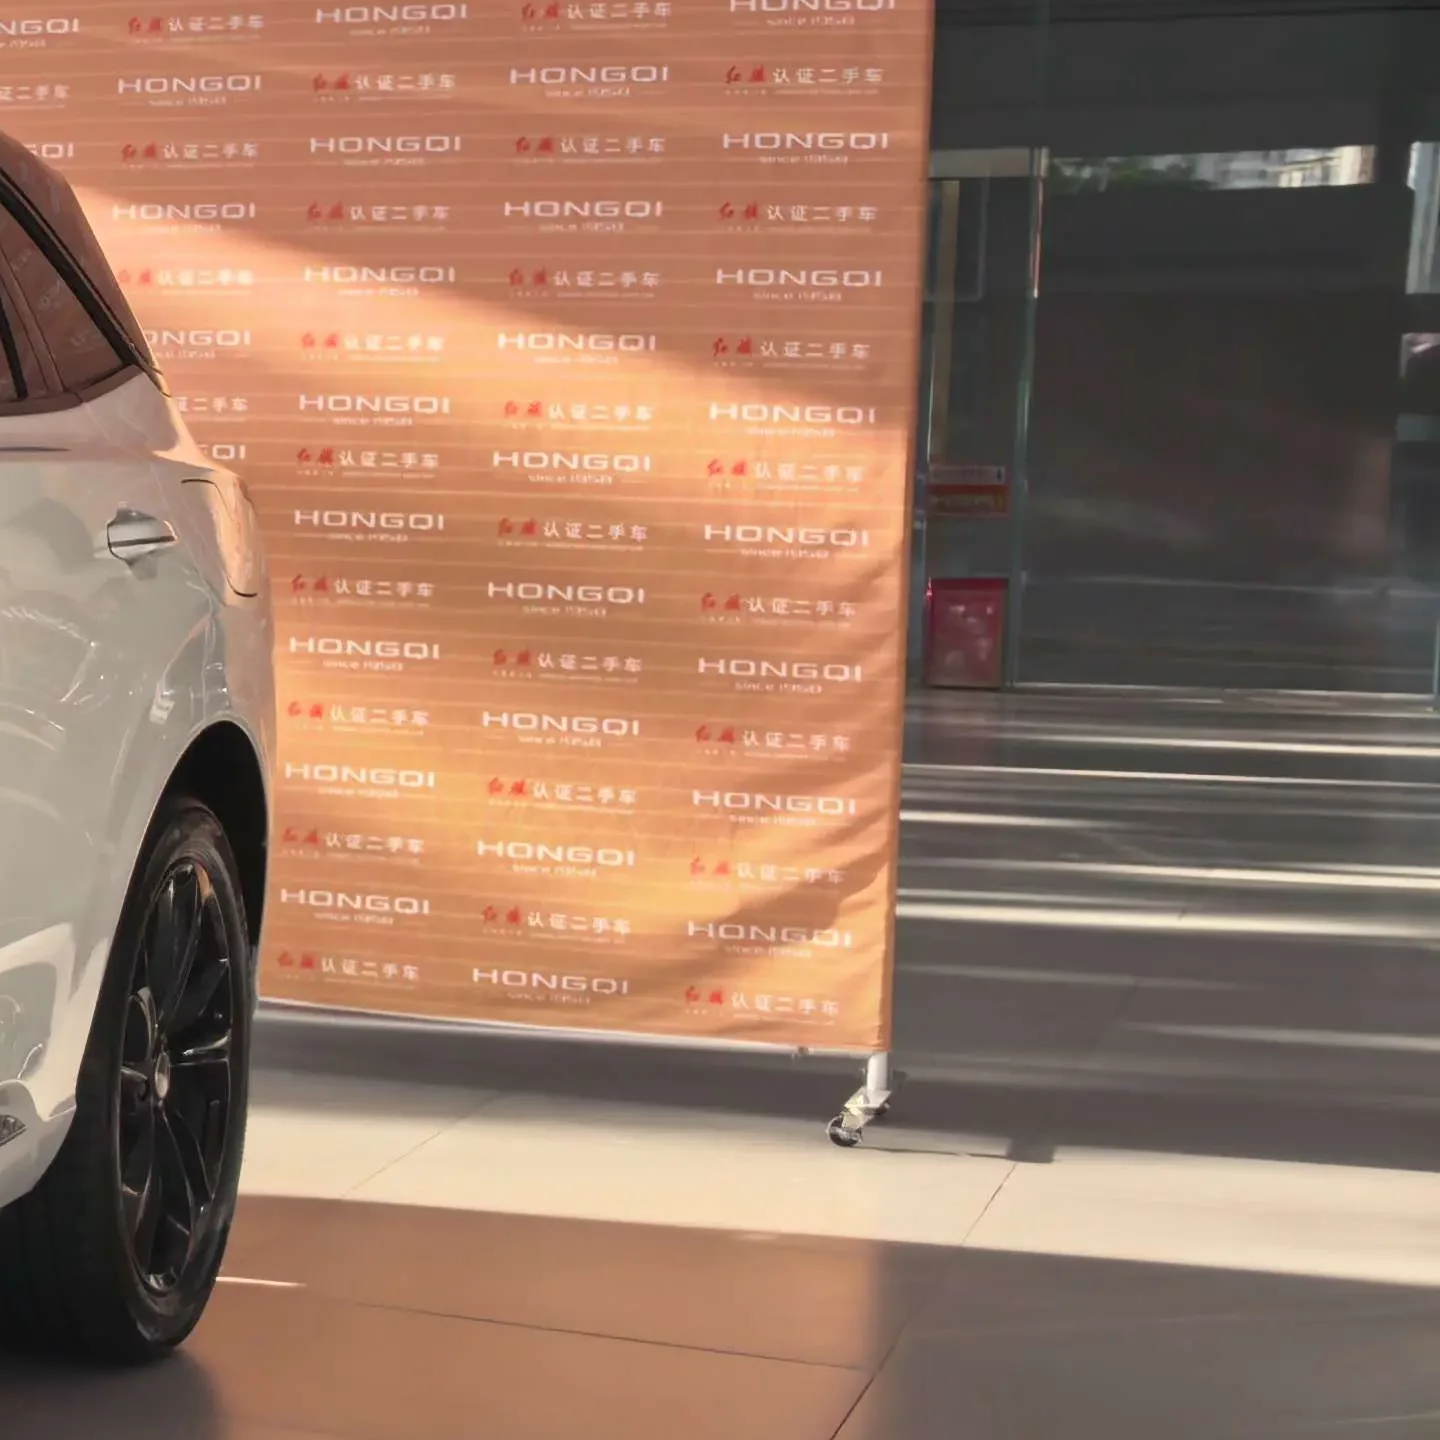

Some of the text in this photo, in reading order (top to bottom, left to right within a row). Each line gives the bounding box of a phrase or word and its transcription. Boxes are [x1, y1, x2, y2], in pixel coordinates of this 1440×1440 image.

[315, 3, 468, 25] HONGQI
[117, 75, 261, 95] HONGQI
[509, 65, 670, 85] HONGQI
[309, 135, 462, 154] HONGQI
[722, 131, 890, 150] HONGQI
[110, 201, 256, 221] HONGQI
[503, 200, 663, 219] HONGQI
[303, 264, 457, 285] HONGQI
[715, 267, 883, 288] HONGQI
[144, 329, 251, 347] NGQI
[497, 332, 656, 352] HONGQI
[298, 388, 451, 415] HONGQI
[708, 401, 876, 425] HONGQI
[492, 450, 652, 473] HONGQI
[293, 508, 445, 531] HONGQI
[703, 523, 870, 548] HONGQI
[487, 580, 646, 605] HONGQI
[289, 635, 440, 661] HONGQI
[697, 656, 863, 683] HONGQI
[481, 710, 640, 737] HONGQI
[283, 761, 436, 789] HONGQI
[691, 788, 857, 817] HONGQI
[476, 839, 637, 868] HONGQI
[279, 887, 430, 916] HONGQI
[687, 920, 854, 949] HONGQI
[471, 967, 629, 995] HONGQI
